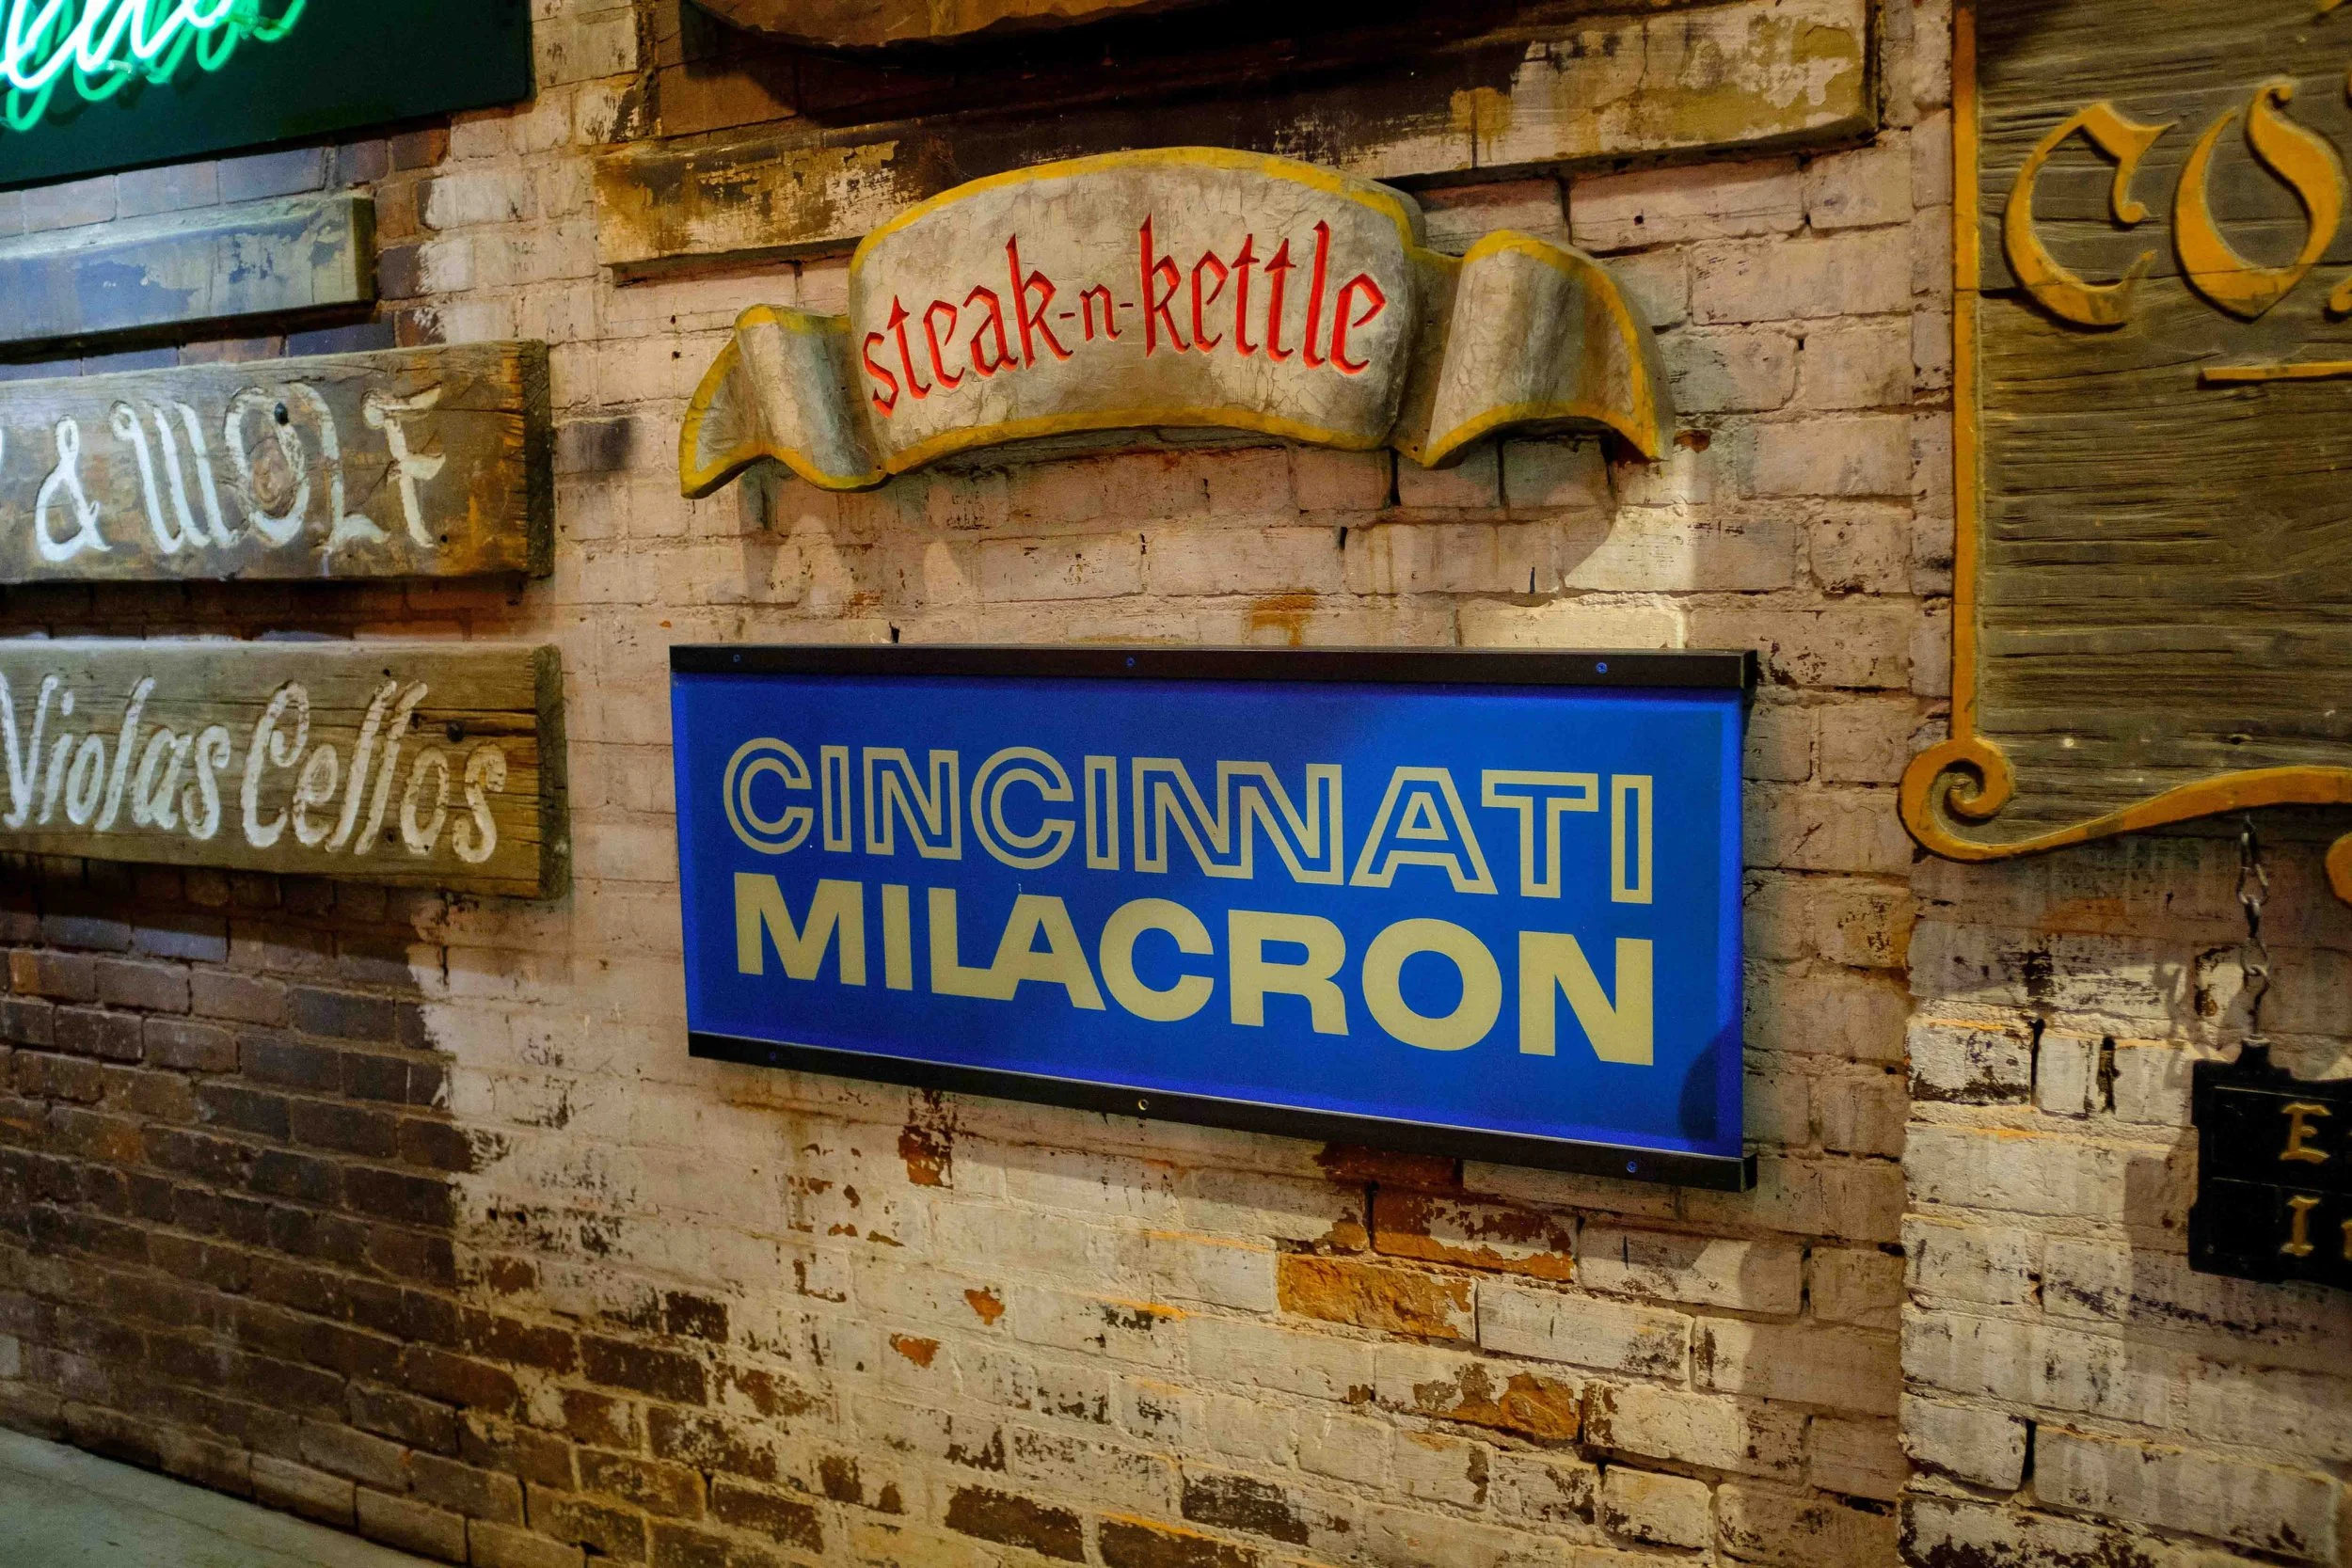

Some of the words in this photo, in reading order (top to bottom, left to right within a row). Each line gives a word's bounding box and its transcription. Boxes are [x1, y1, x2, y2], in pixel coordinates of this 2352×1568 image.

[2005, 75, 2352, 325] CO
[862, 213, 1387, 419] steak-n-kettle
[35, 415, 113, 562] &
[109, 383, 447, 556] WOLF
[0, 672, 230, 841] Violas
[241, 680, 508, 863] Cellos
[723, 736, 1654, 904] CINCINNATI
[733, 871, 1654, 1067] MILACRON
